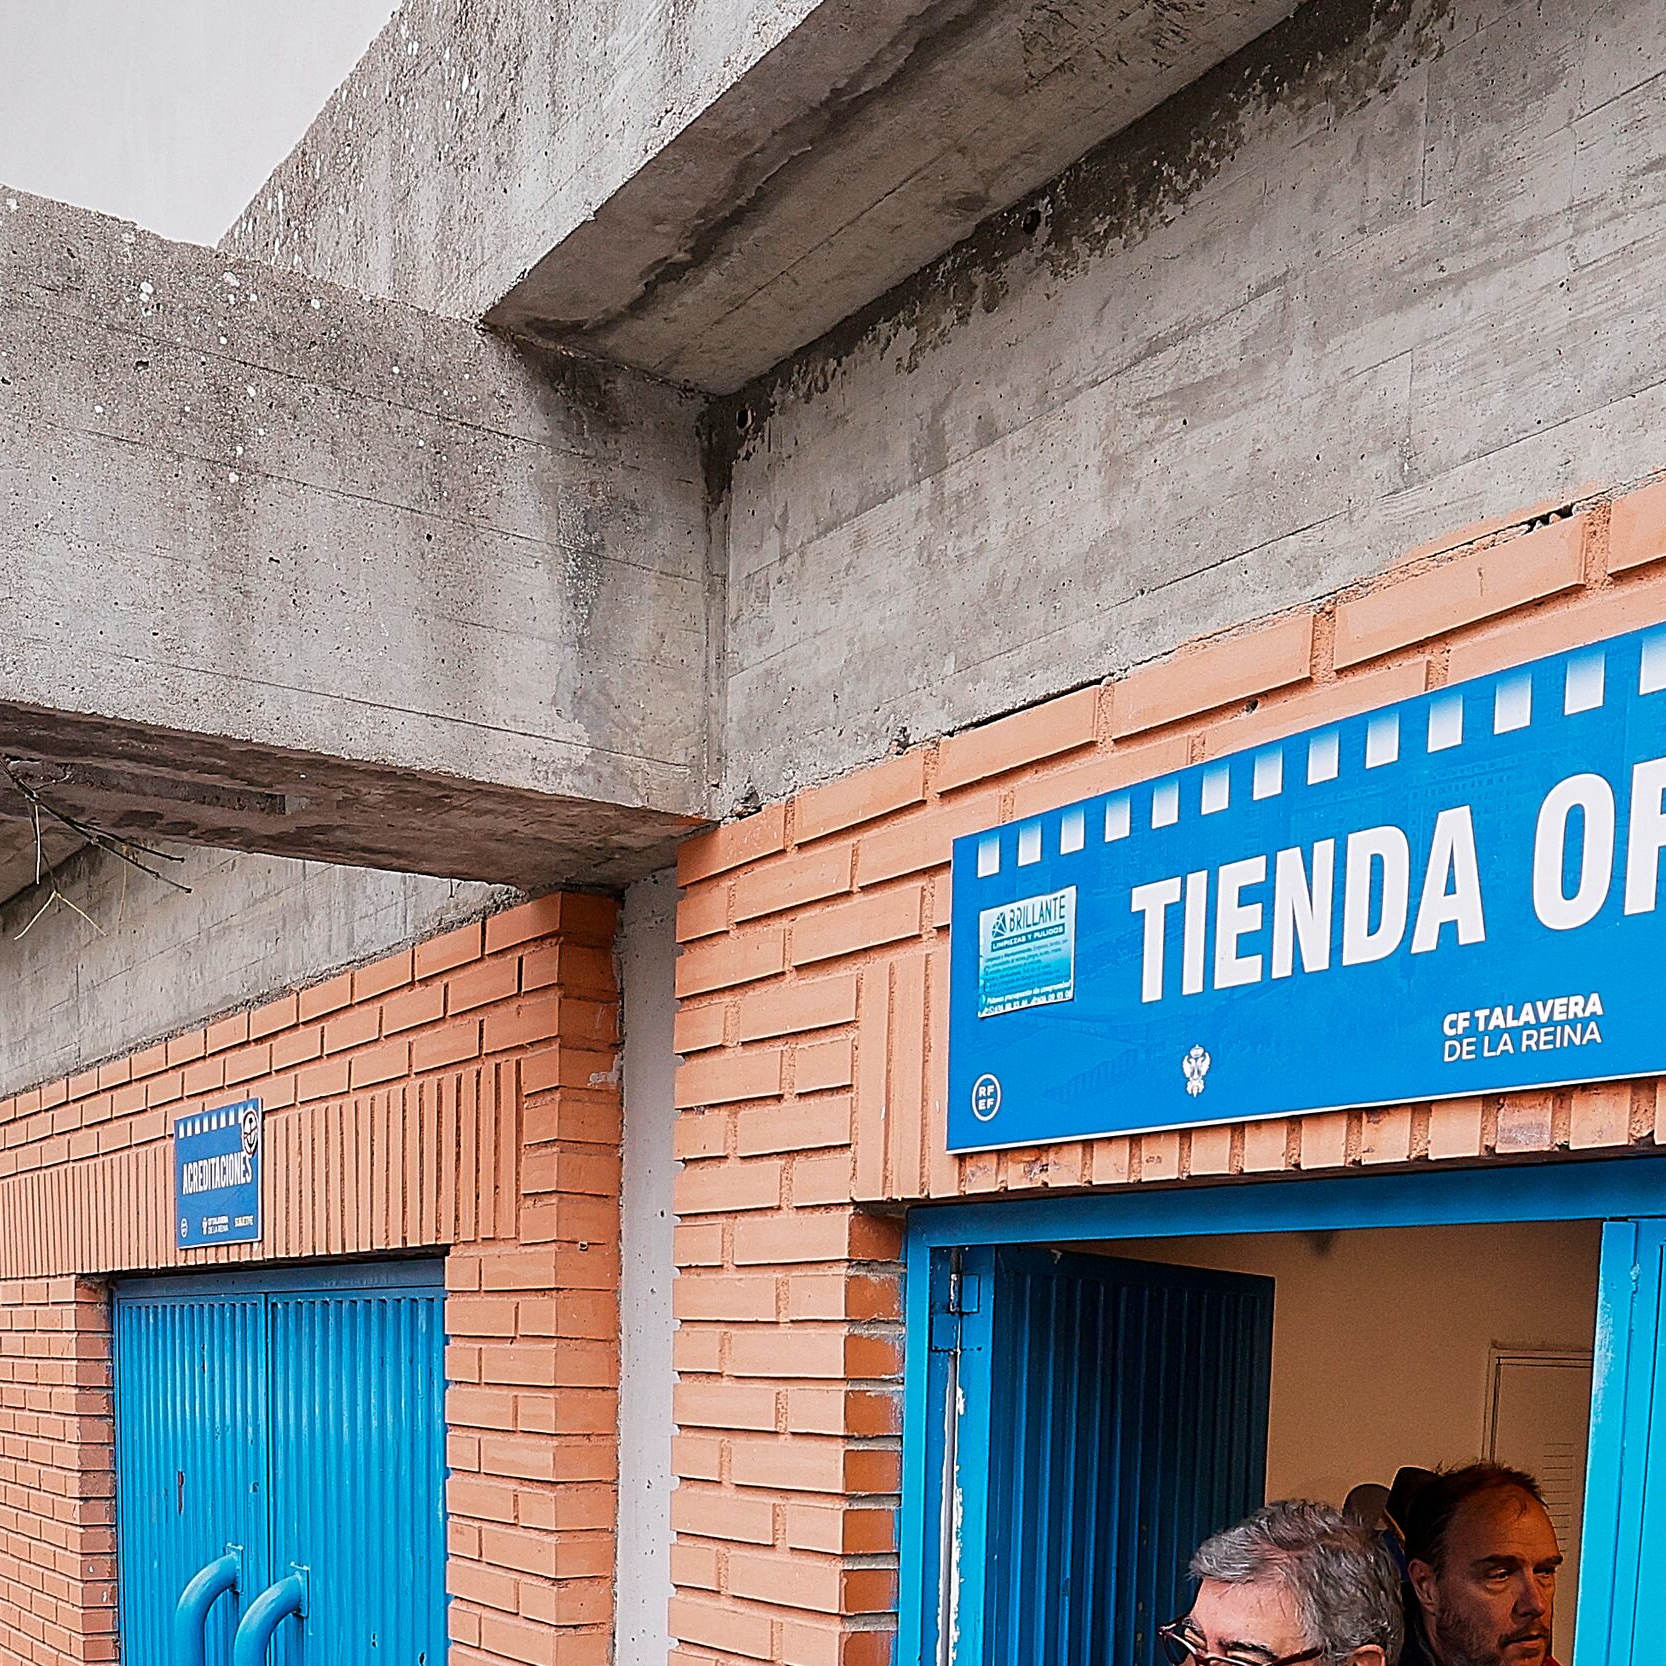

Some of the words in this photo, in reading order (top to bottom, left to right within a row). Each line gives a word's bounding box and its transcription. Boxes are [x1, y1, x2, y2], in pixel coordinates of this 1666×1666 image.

[1009, 895, 1066, 933] BRILLANTE
[1132, 804, 1487, 1003] TIENDA
[1443, 1011, 1471, 1036] CF
[1474, 992, 1604, 1032] TALAVERA
[1443, 1037, 1477, 1063] DE
[1483, 1032, 1514, 1058] LA
[1521, 1020, 1602, 1053] REINA
[977, 1098, 994, 1111] EF
[978, 1085, 994, 1098] RF
[182, 1152, 253, 1195] ACREDITACIONES
